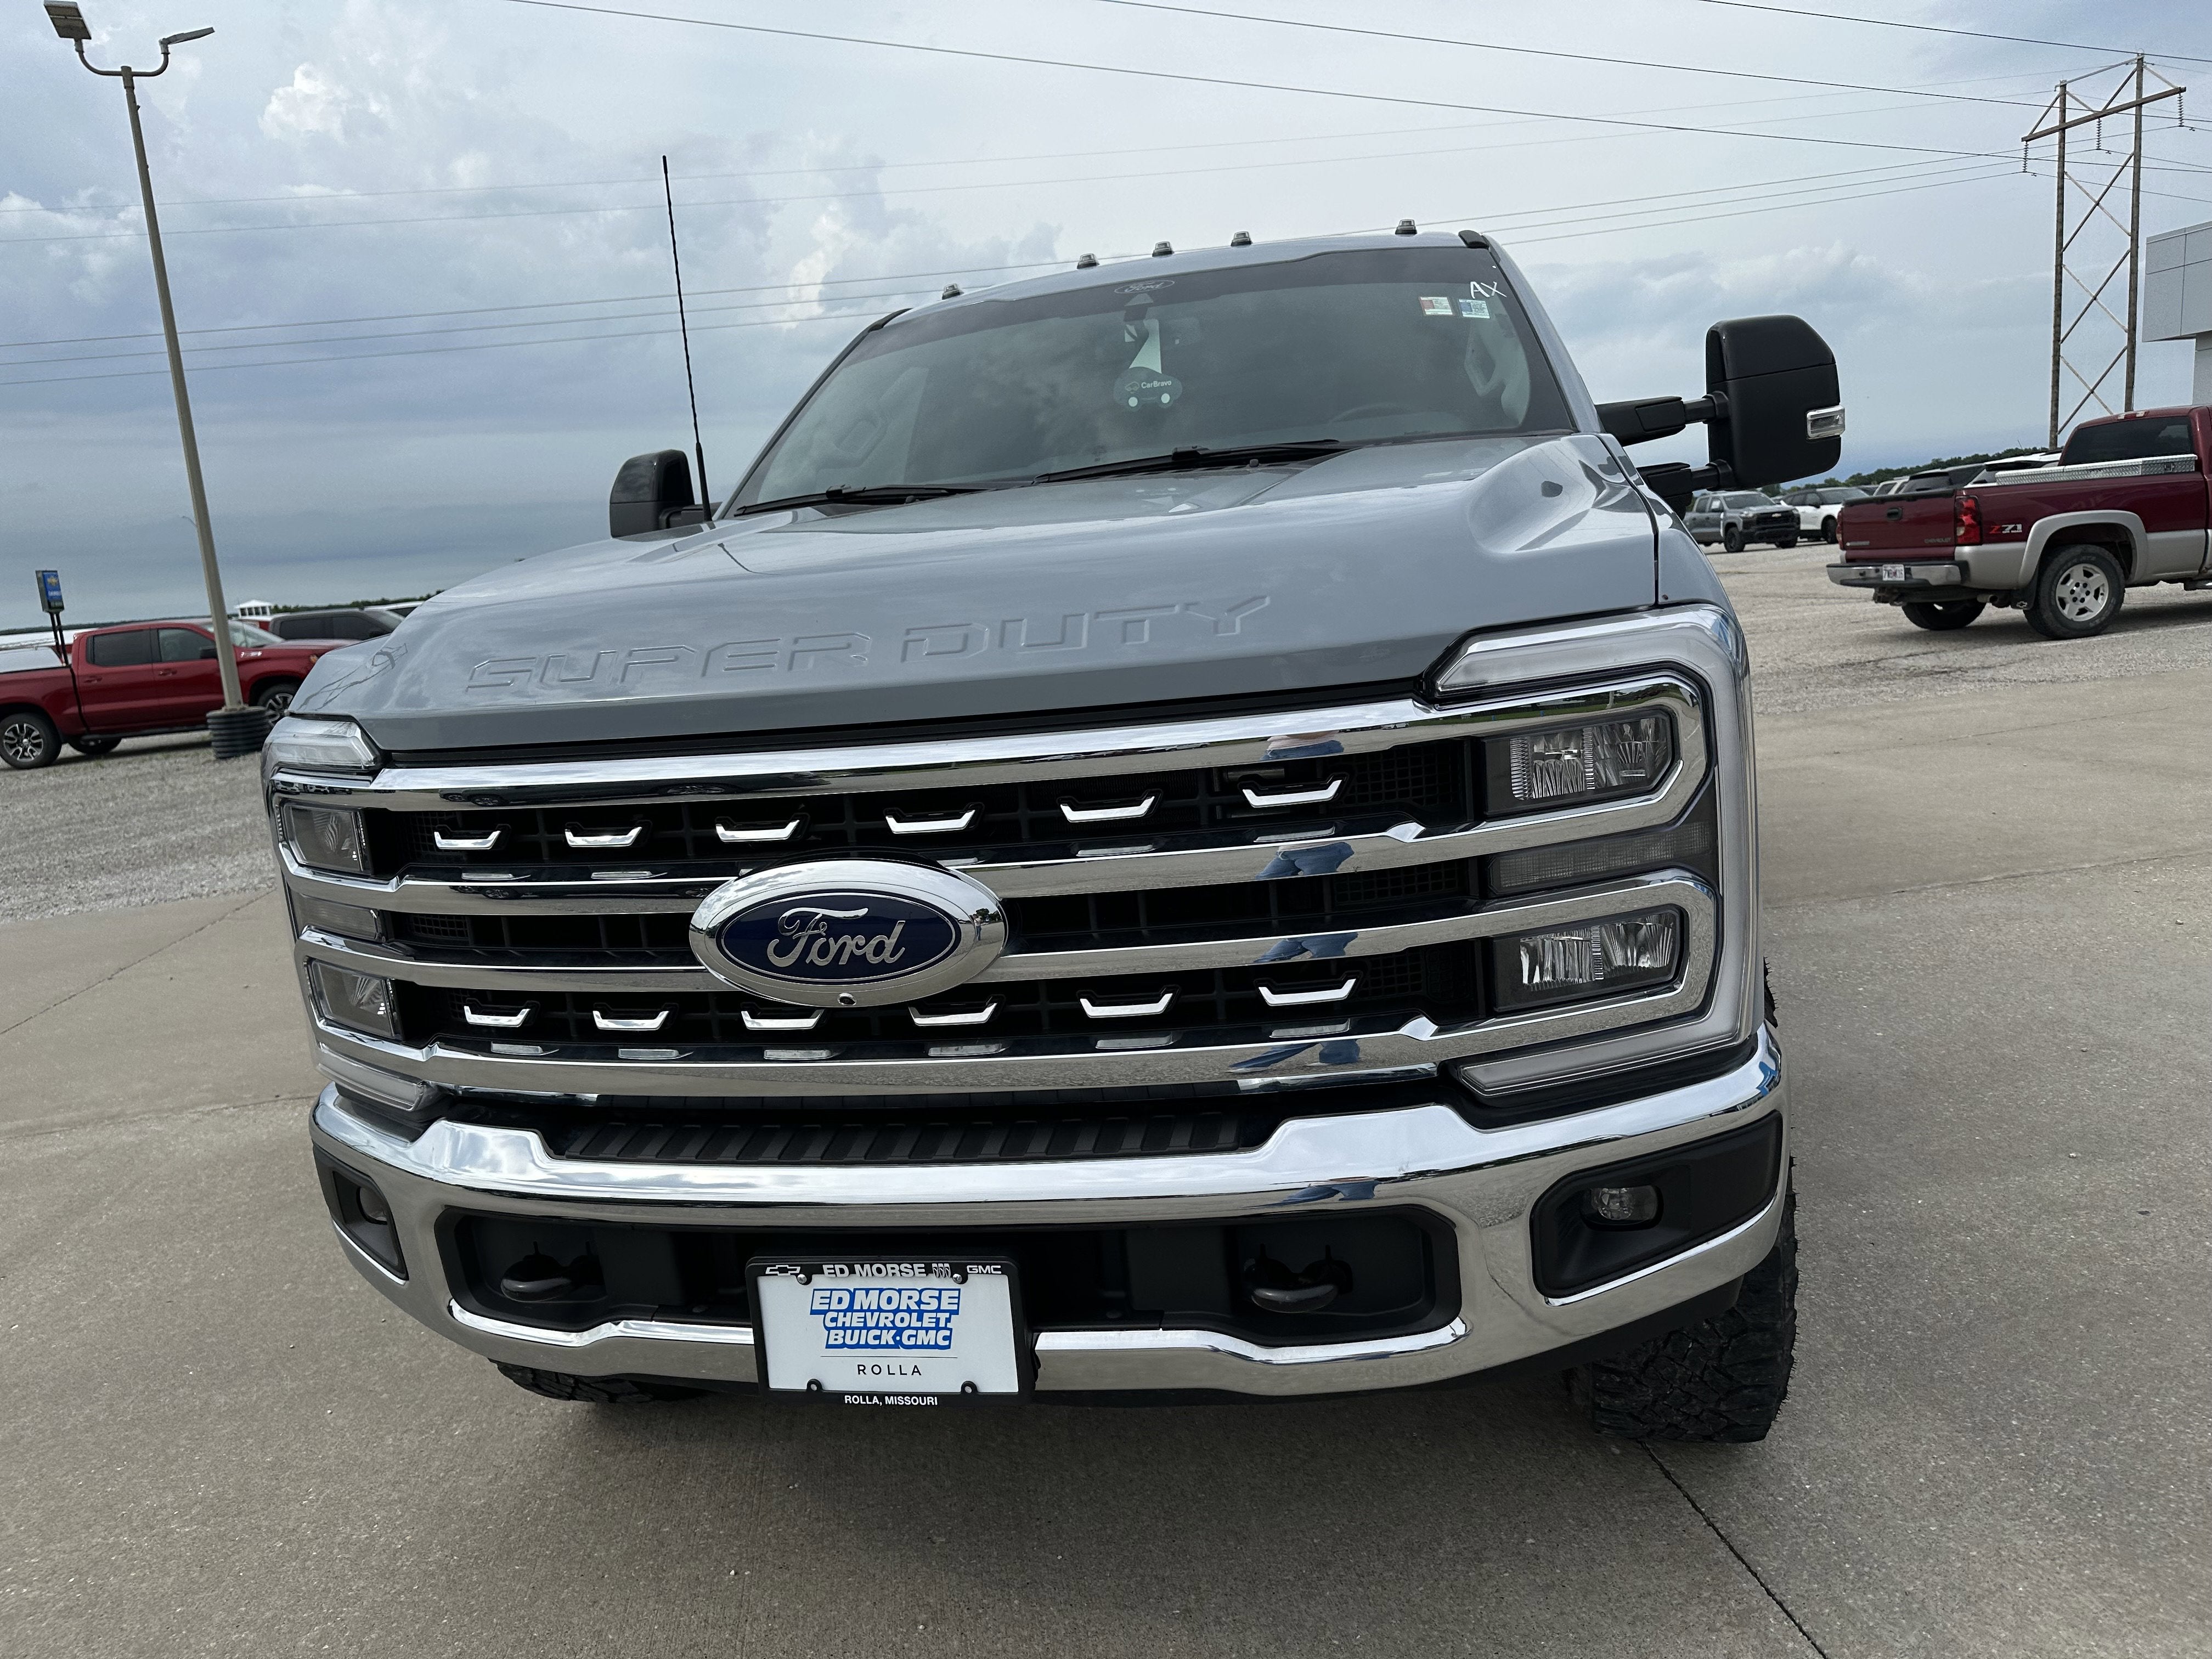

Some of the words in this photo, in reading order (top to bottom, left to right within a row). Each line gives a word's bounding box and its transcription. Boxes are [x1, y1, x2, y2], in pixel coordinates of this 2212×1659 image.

[1124, 281, 1164, 292] Ford
[1470, 281, 1507, 298] AX
[1141, 380, 1172, 389] CarBravo
[1989, 523, 2023, 534] Z71
[465, 633, 871, 693] SUPER
[900, 595, 1270, 663] DUTY
[767, 907, 906, 967] Ford
[822, 1264, 849, 1278] ED
[854, 1263, 927, 1278] MORSE
[966, 1265, 1002, 1274] GMC
[812, 1290, 850, 1311] ED
[854, 1290, 959, 1311] MORSE
[824, 1311, 950, 1328] CHEVROLET
[857, 1364, 922, 1376] ROLLA
[844, 1395, 882, 1406] ROLLA,
[885, 1396, 938, 1406] MISSOURI
